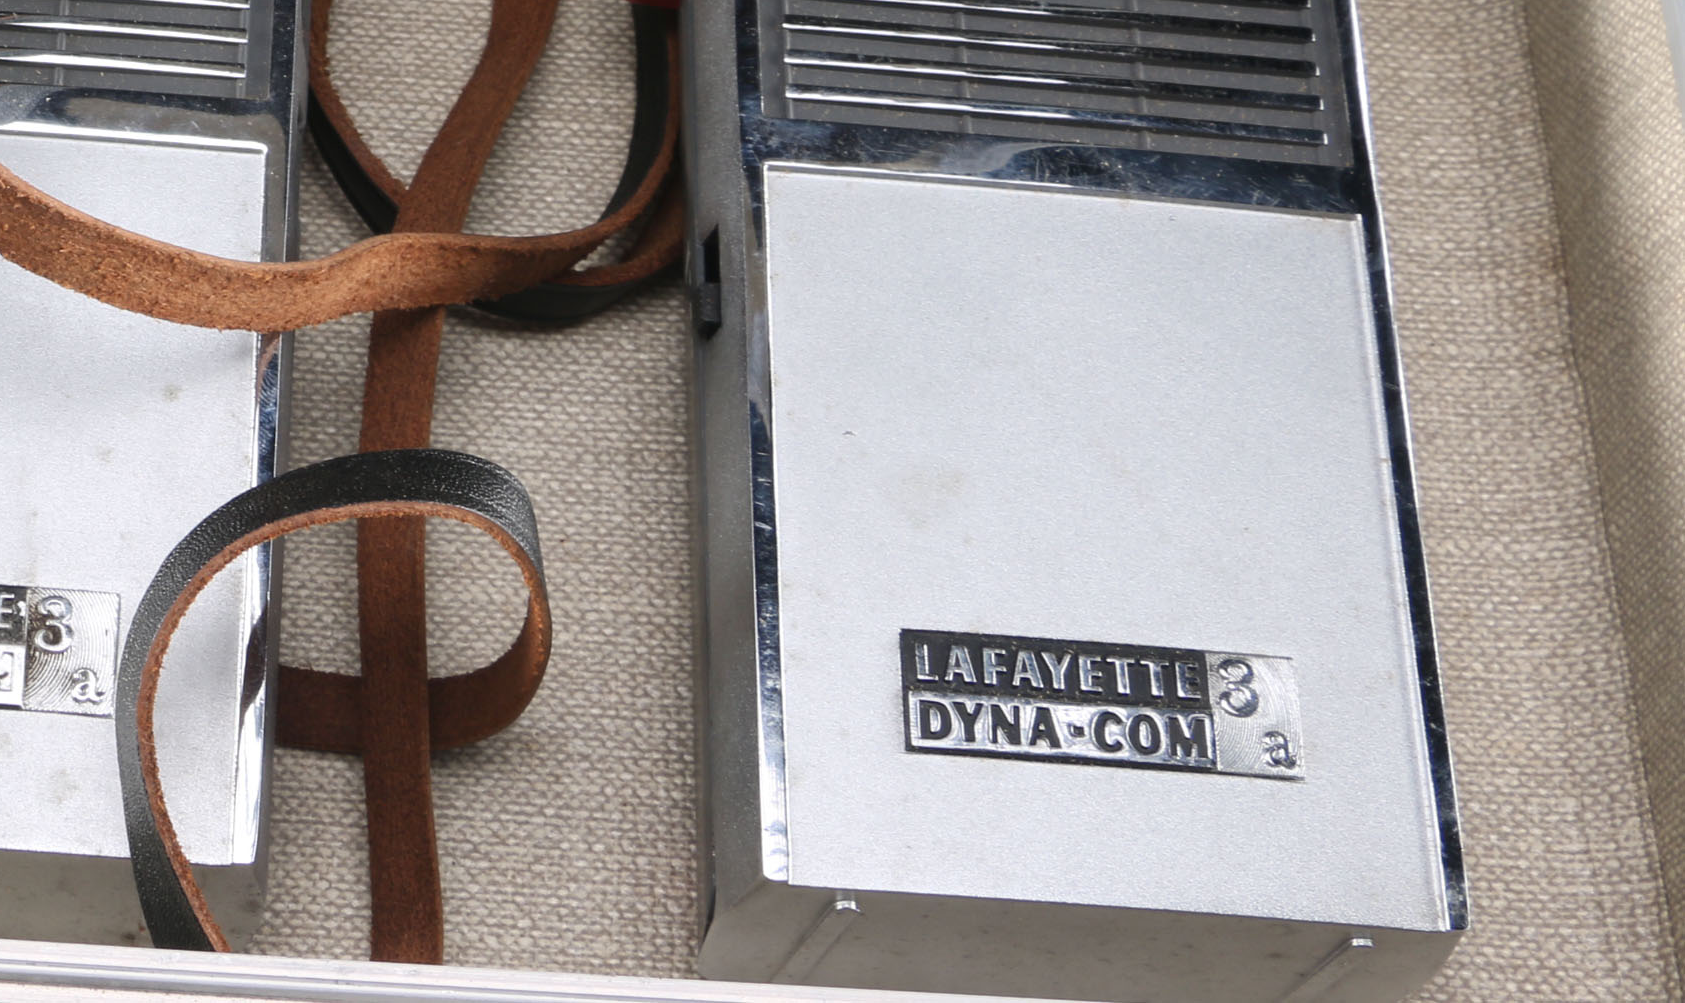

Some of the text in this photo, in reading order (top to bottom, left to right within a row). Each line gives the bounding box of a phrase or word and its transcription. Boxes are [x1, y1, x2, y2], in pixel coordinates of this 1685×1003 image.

[34, 597, 74, 653] 3
[71, 667, 103, 703] a
[915, 642, 1202, 698] LAFAYETTE
[1217, 658, 1260, 719] 3
[1264, 731, 1297, 770] a
